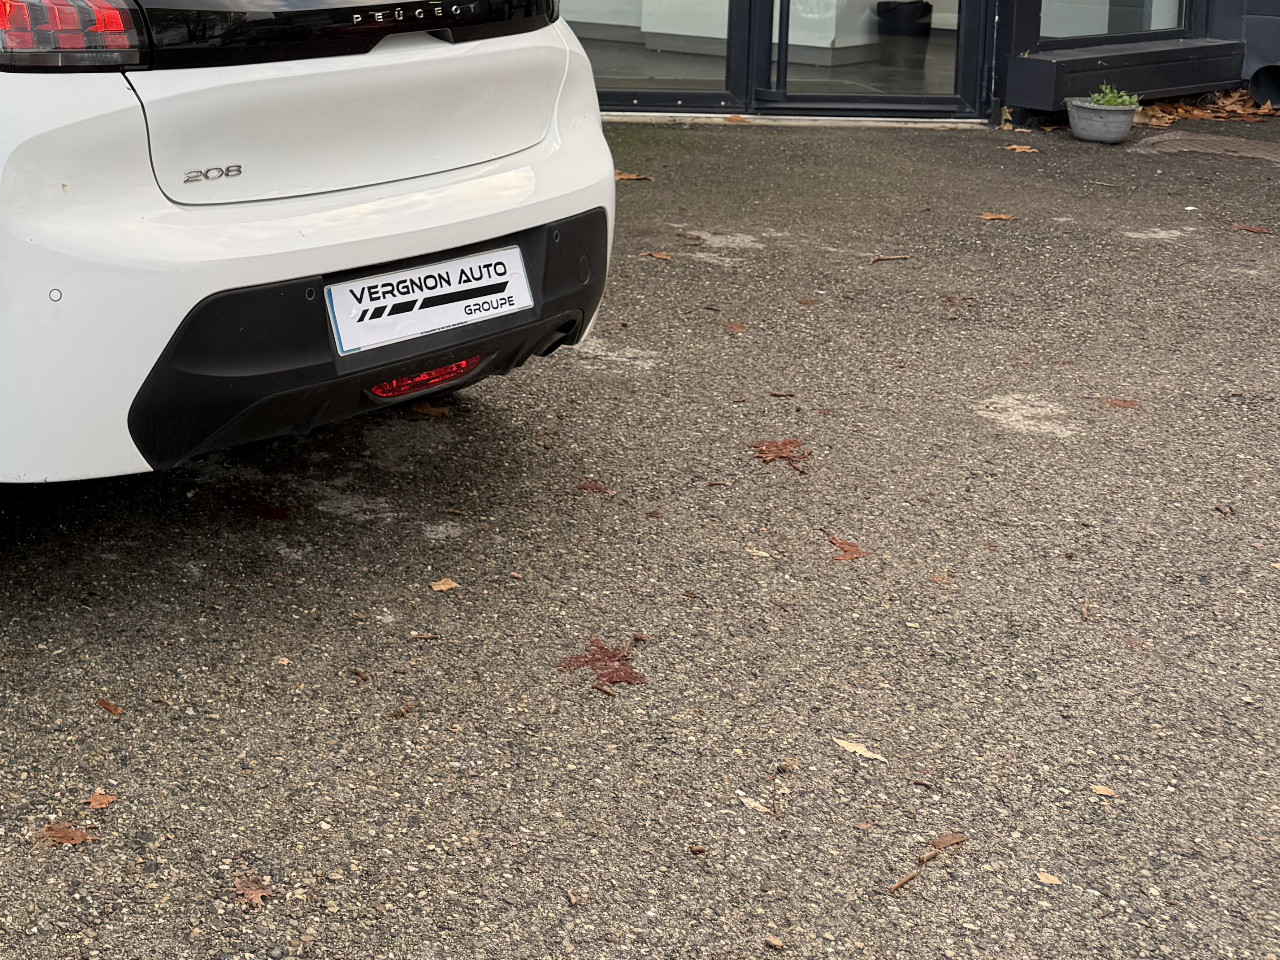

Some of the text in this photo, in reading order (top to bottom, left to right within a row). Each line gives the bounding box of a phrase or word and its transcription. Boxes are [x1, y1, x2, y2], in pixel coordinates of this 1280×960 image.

[352, 3, 478, 25] PEUGEOT
[183, 164, 242, 184] 208
[349, 261, 507, 305] VERGNON AUTO
[464, 295, 515, 316] GROUPE
